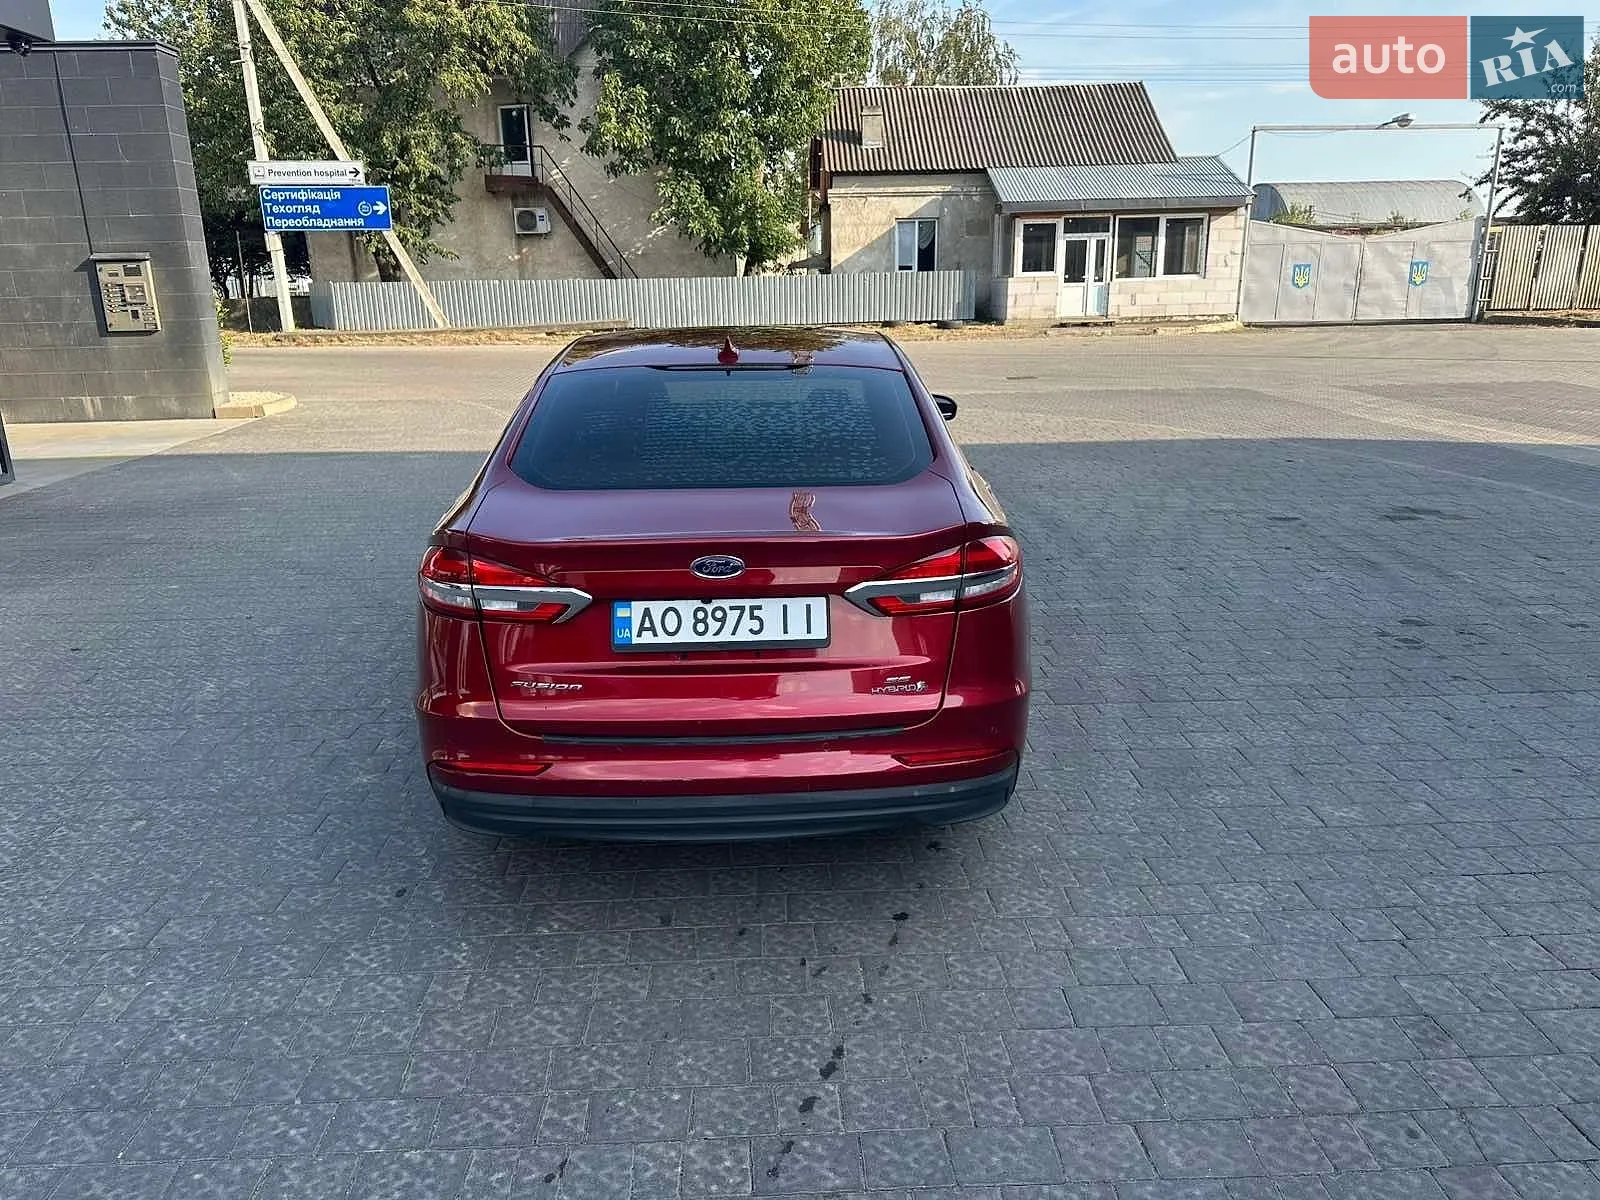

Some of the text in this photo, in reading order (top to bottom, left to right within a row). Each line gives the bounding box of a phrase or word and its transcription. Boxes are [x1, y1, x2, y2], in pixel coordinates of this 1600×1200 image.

[267, 168, 347, 179] Prevention hospital
[262, 189, 341, 202] Сертифікація
[264, 203, 320, 214] Техогляд
[266, 216, 364, 229] Переобладнання
[703, 559, 737, 573] Ford
[636, 606, 682, 638] AO
[692, 604, 765, 636] 8975
[616, 630, 631, 638] UA
[510, 681, 583, 690] FUSION
[871, 684, 917, 694] HYBRID
